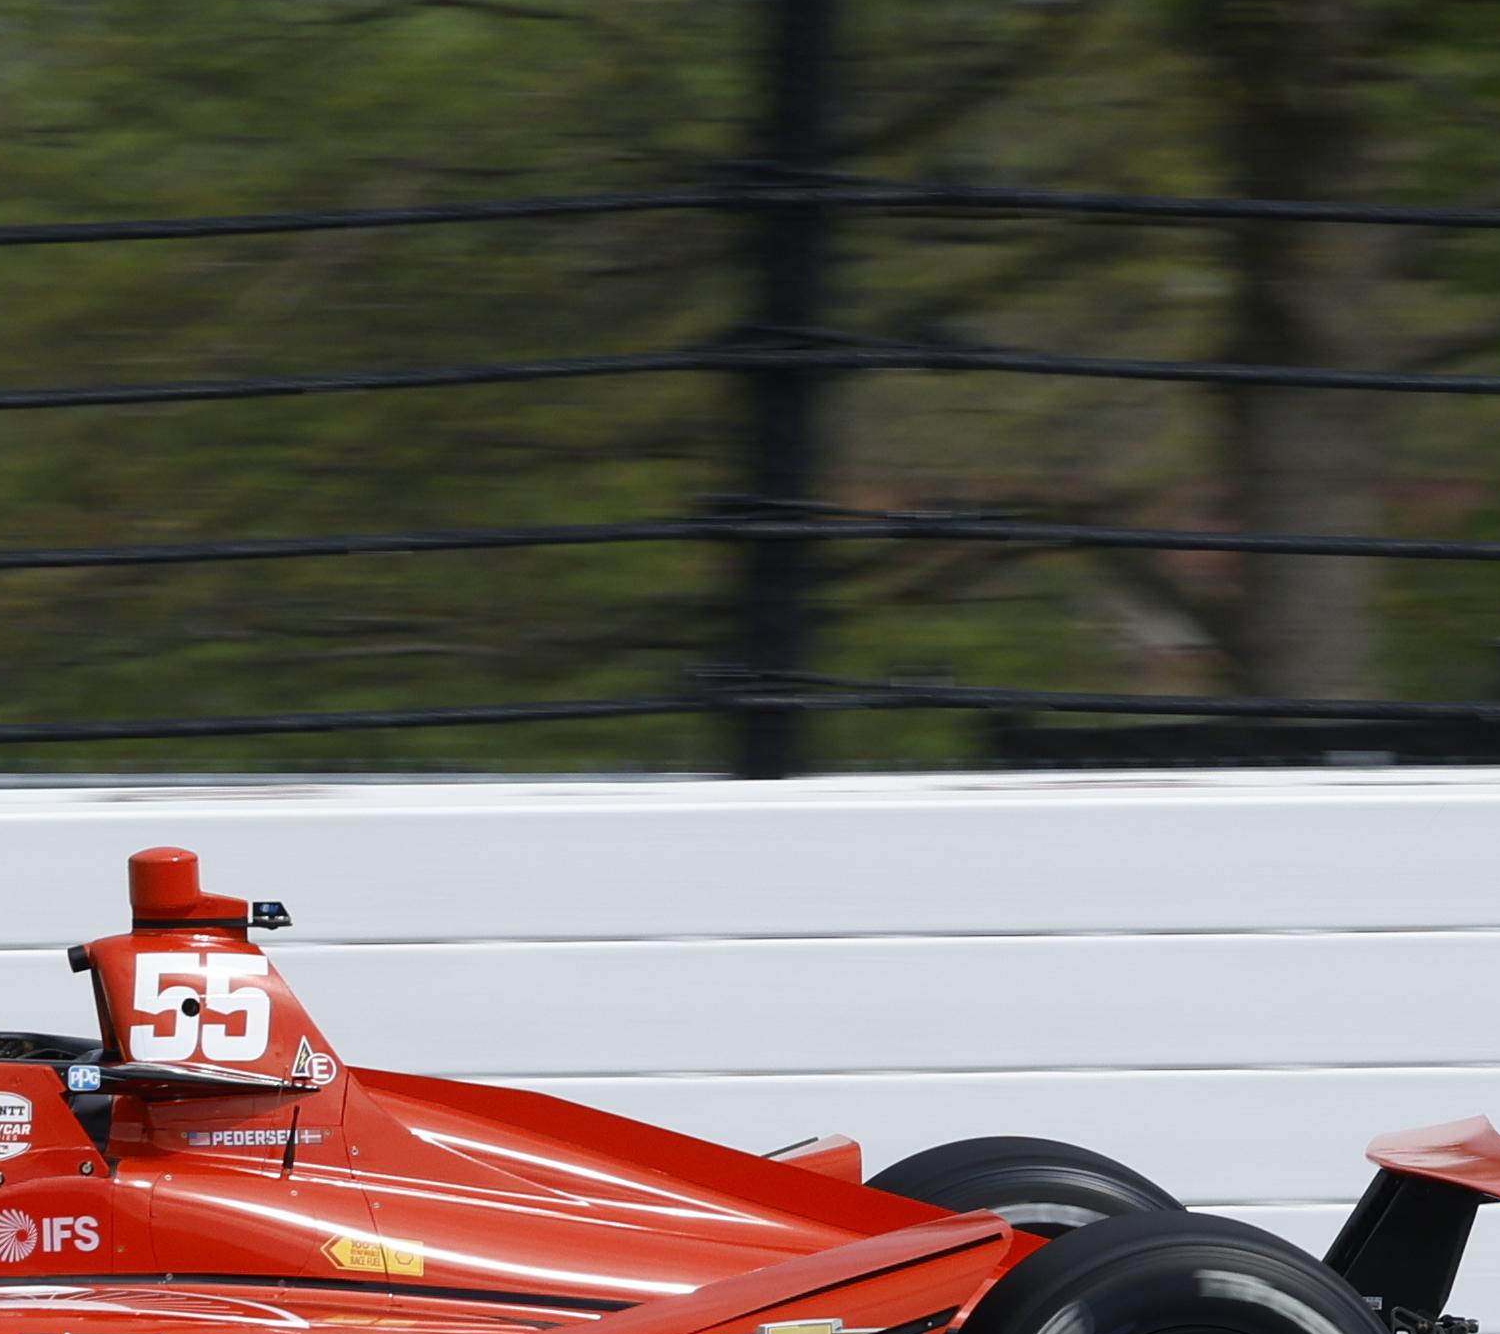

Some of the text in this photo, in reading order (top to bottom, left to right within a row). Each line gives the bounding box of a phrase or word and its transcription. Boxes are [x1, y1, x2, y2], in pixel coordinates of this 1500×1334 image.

[130, 953, 270, 1061] 55
[71, 1069, 100, 1088] PPG
[313, 1059, 328, 1078] E
[42, 1216, 99, 1252] IFS
